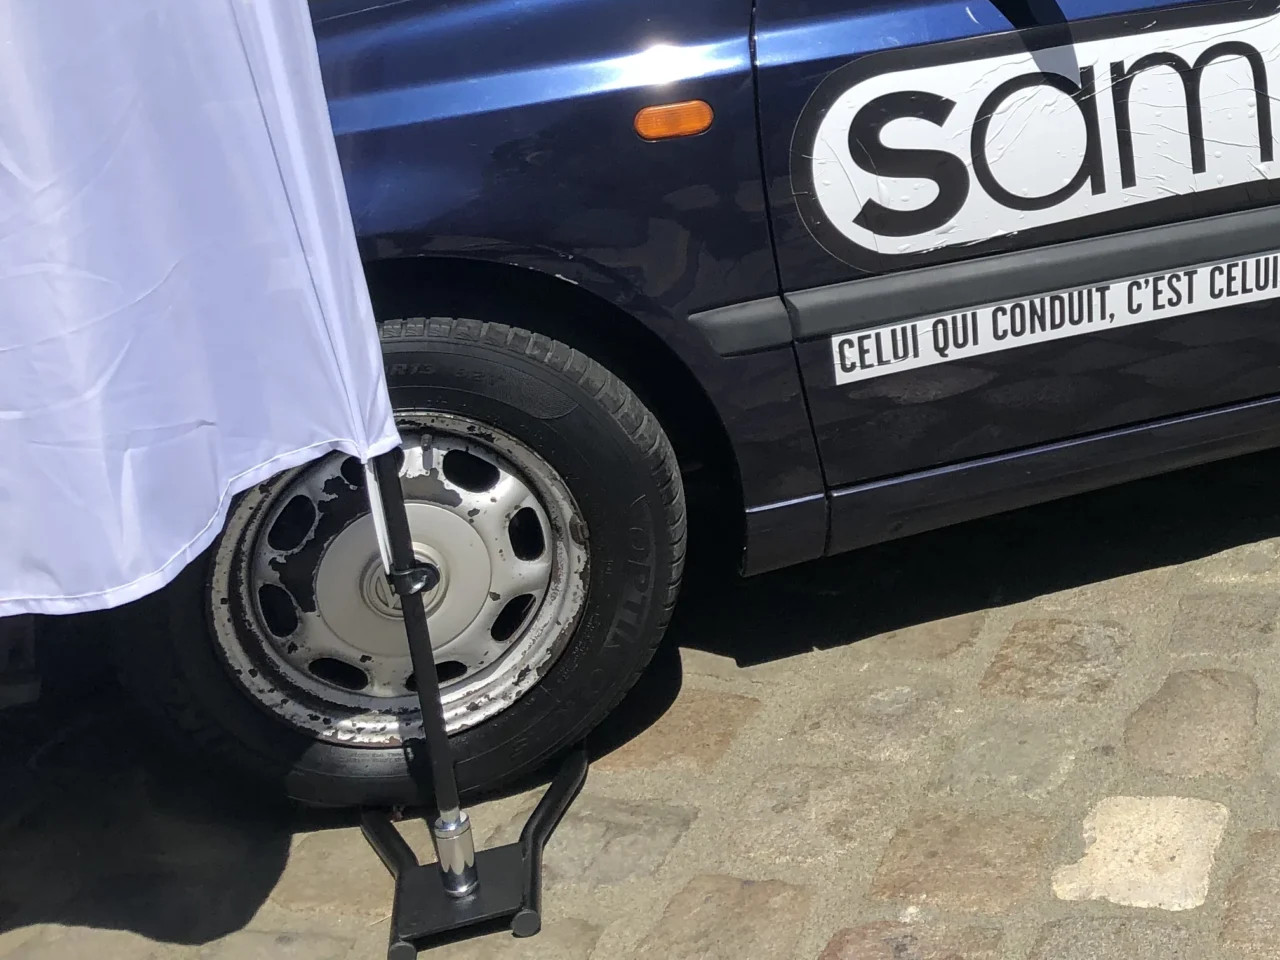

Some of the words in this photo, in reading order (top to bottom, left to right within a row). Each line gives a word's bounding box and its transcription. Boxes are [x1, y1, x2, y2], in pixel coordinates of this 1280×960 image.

[847, 40, 1275, 238] sam
[838, 323, 920, 373] CELUI
[932, 311, 980, 358] QUI
[991, 285, 1116, 341] CONDUIT,
[1127, 269, 1198, 315] C'EST
[1208, 255, 1278, 300] CELUI
